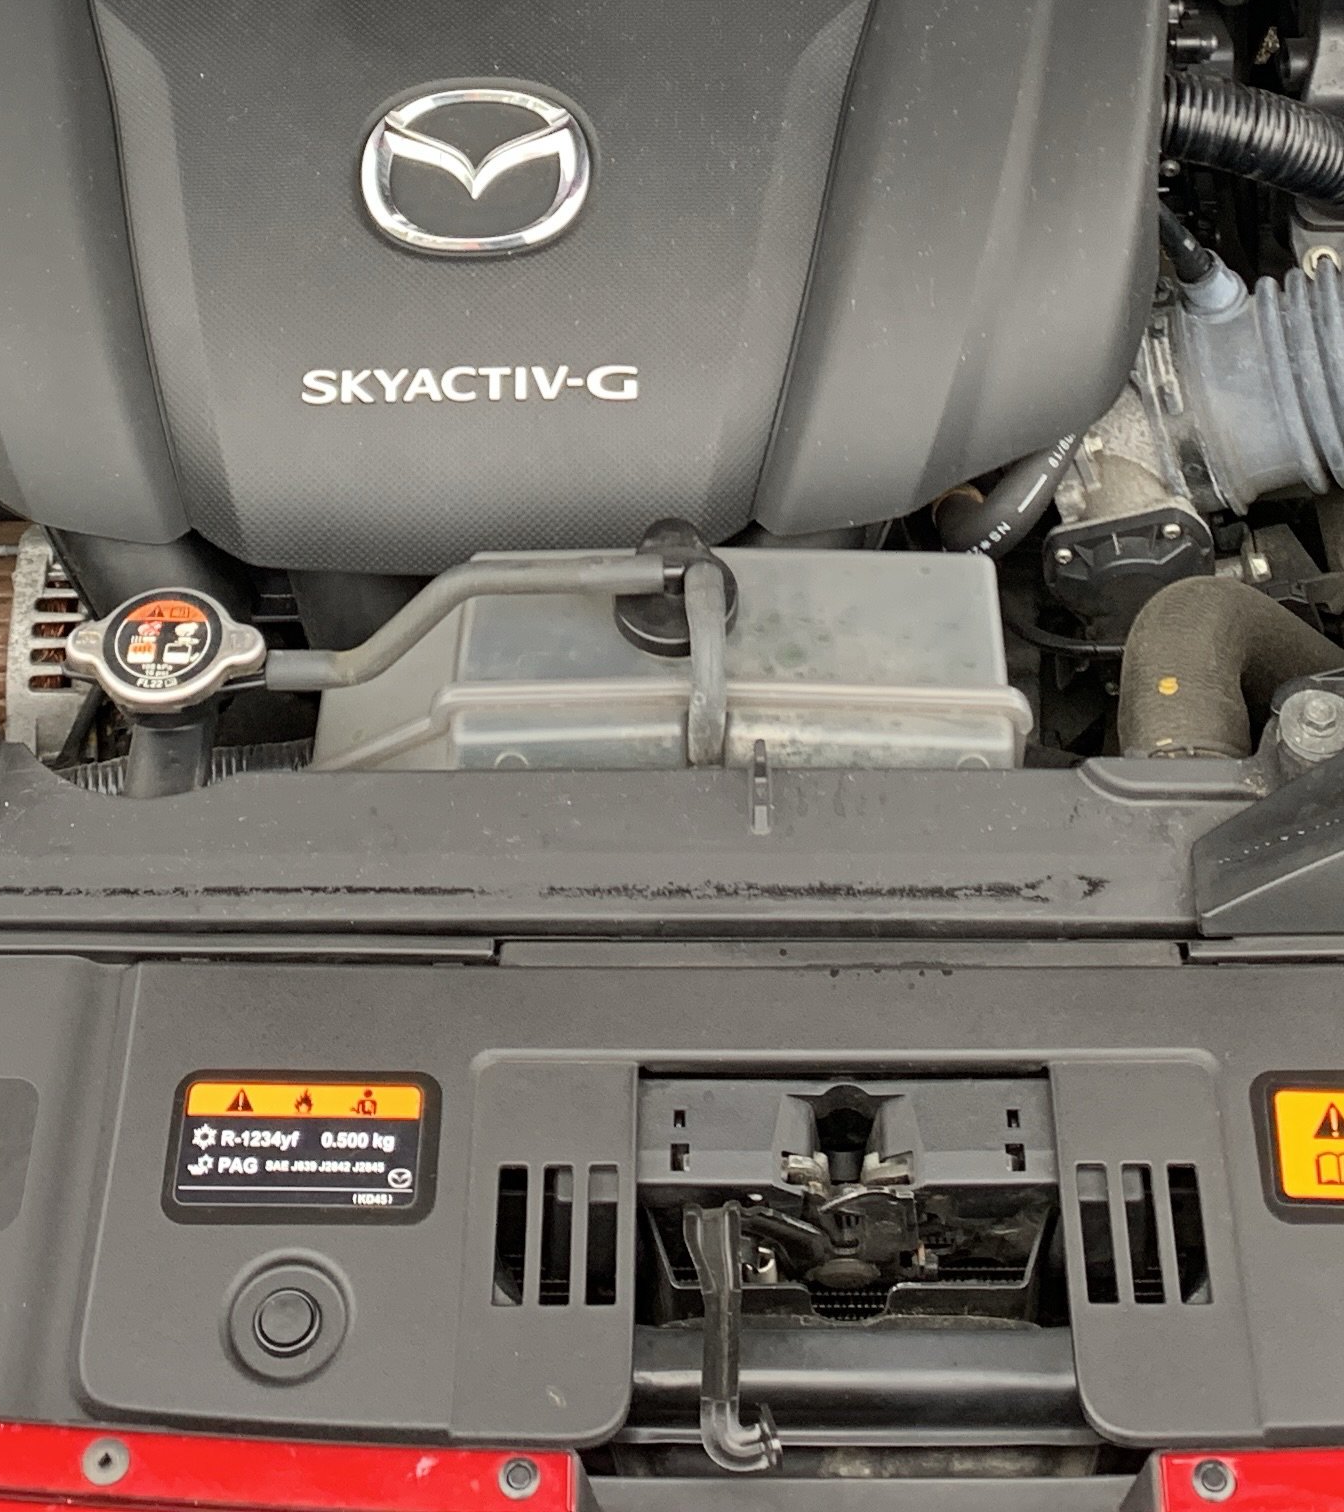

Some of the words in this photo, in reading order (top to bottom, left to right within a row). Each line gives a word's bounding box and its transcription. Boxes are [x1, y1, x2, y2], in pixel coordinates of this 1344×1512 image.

[301, 364, 639, 405] SKYACTIV-G
[136, 677, 163, 689] FL22
[220, 1129, 300, 1151] R-1234yf
[321, 1131, 369, 1149] 0.500
[371, 1131, 395, 1152] kg
[217, 1156, 258, 1174] PAG
[265, 1160, 290, 1172] SAE
